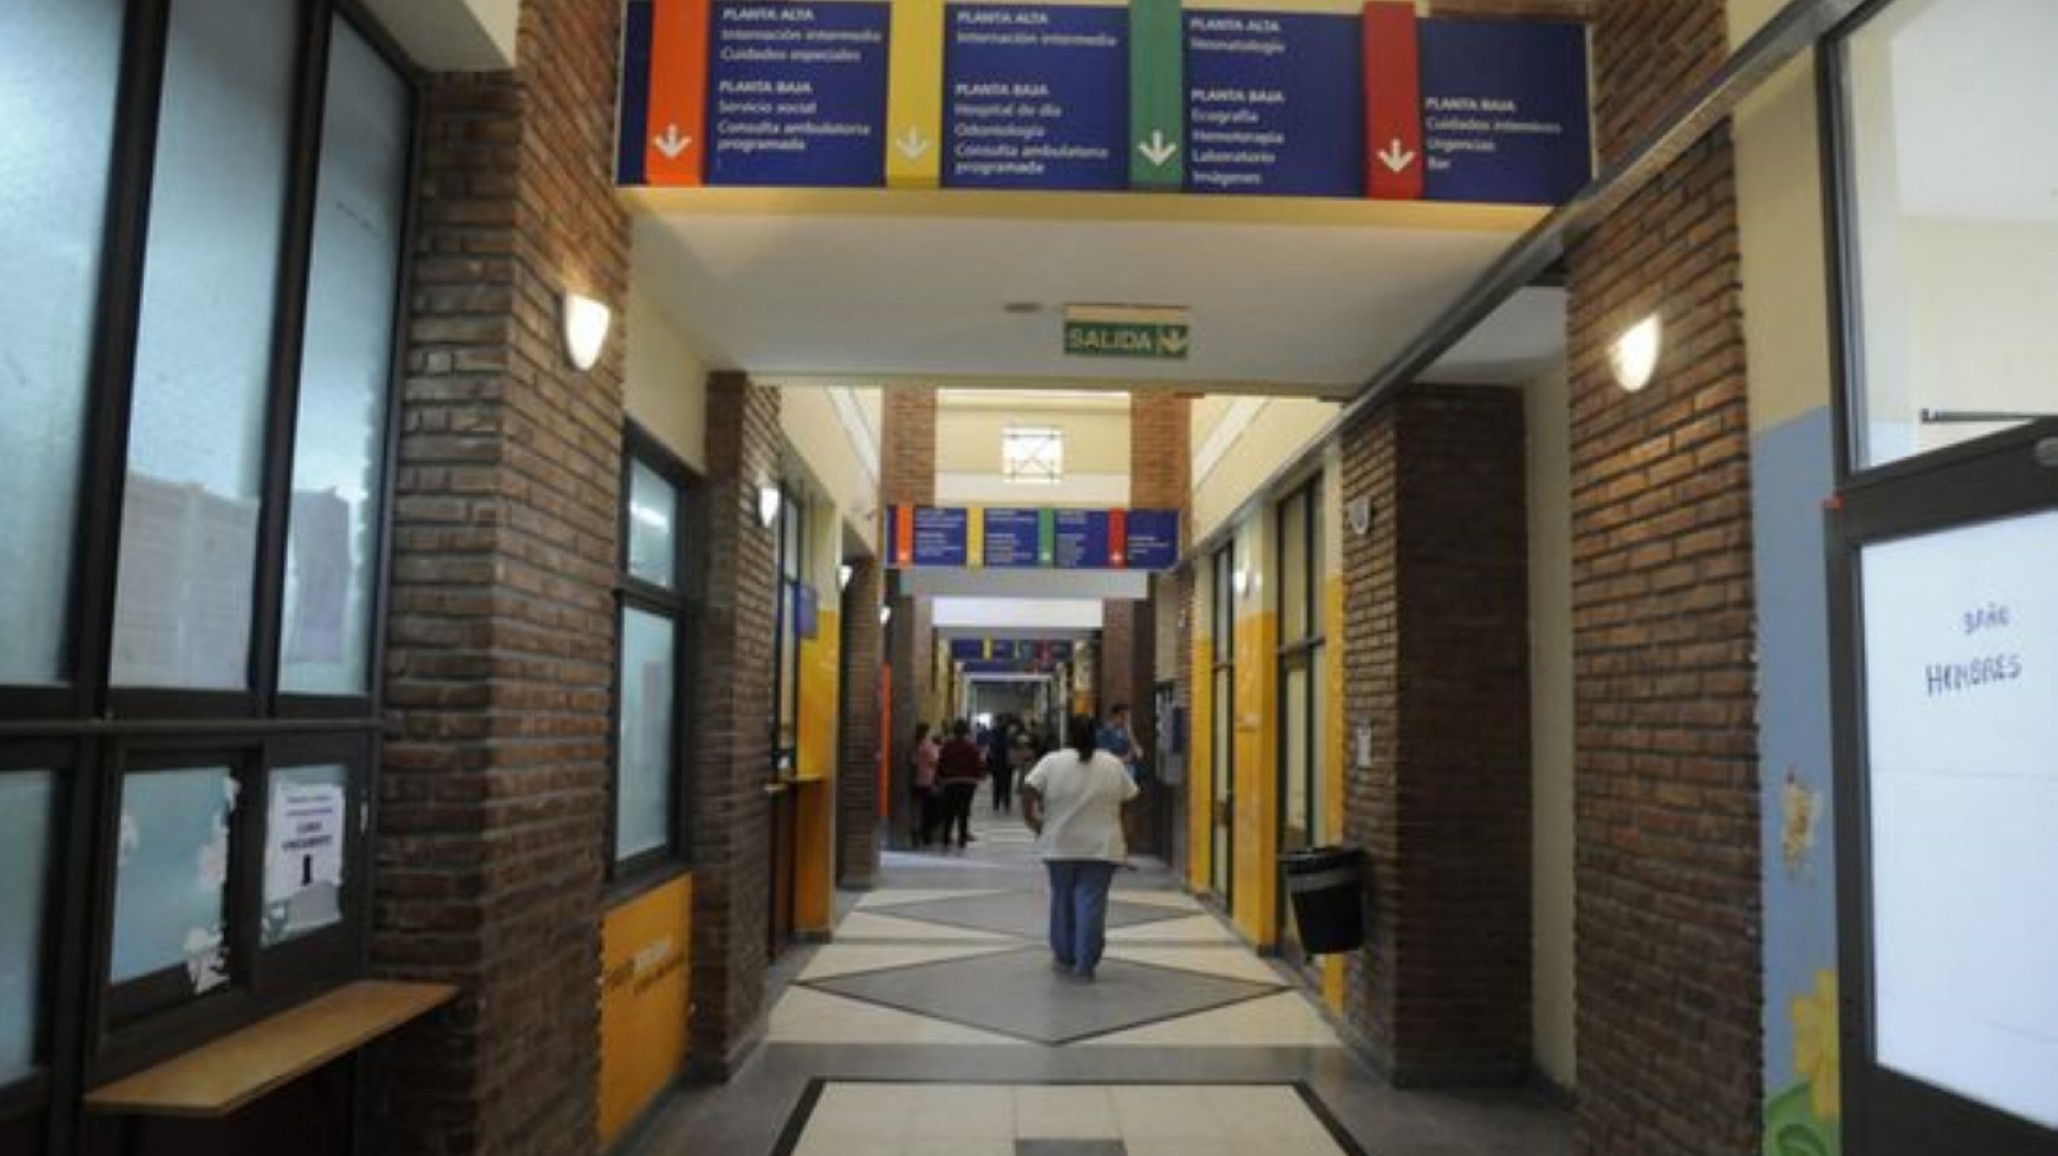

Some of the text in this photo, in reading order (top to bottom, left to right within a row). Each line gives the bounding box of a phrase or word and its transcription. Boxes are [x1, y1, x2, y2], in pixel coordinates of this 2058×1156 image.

[722, 7, 816, 21] PLANTA ALTA
[957, 10, 1049, 25] PLANTA ALTA
[1190, 17, 1282, 33] PLANTA ALTA
[719, 81, 813, 94] PLANTA BAJA
[955, 84, 1050, 97] PLANTA BAJA
[1190, 89, 1285, 104] PLANTA BAJA
[1425, 98, 1517, 113] PLANTA BAJA
[1427, 154, 1450, 170] Bar
[1068, 326, 1153, 350] SALIDA
